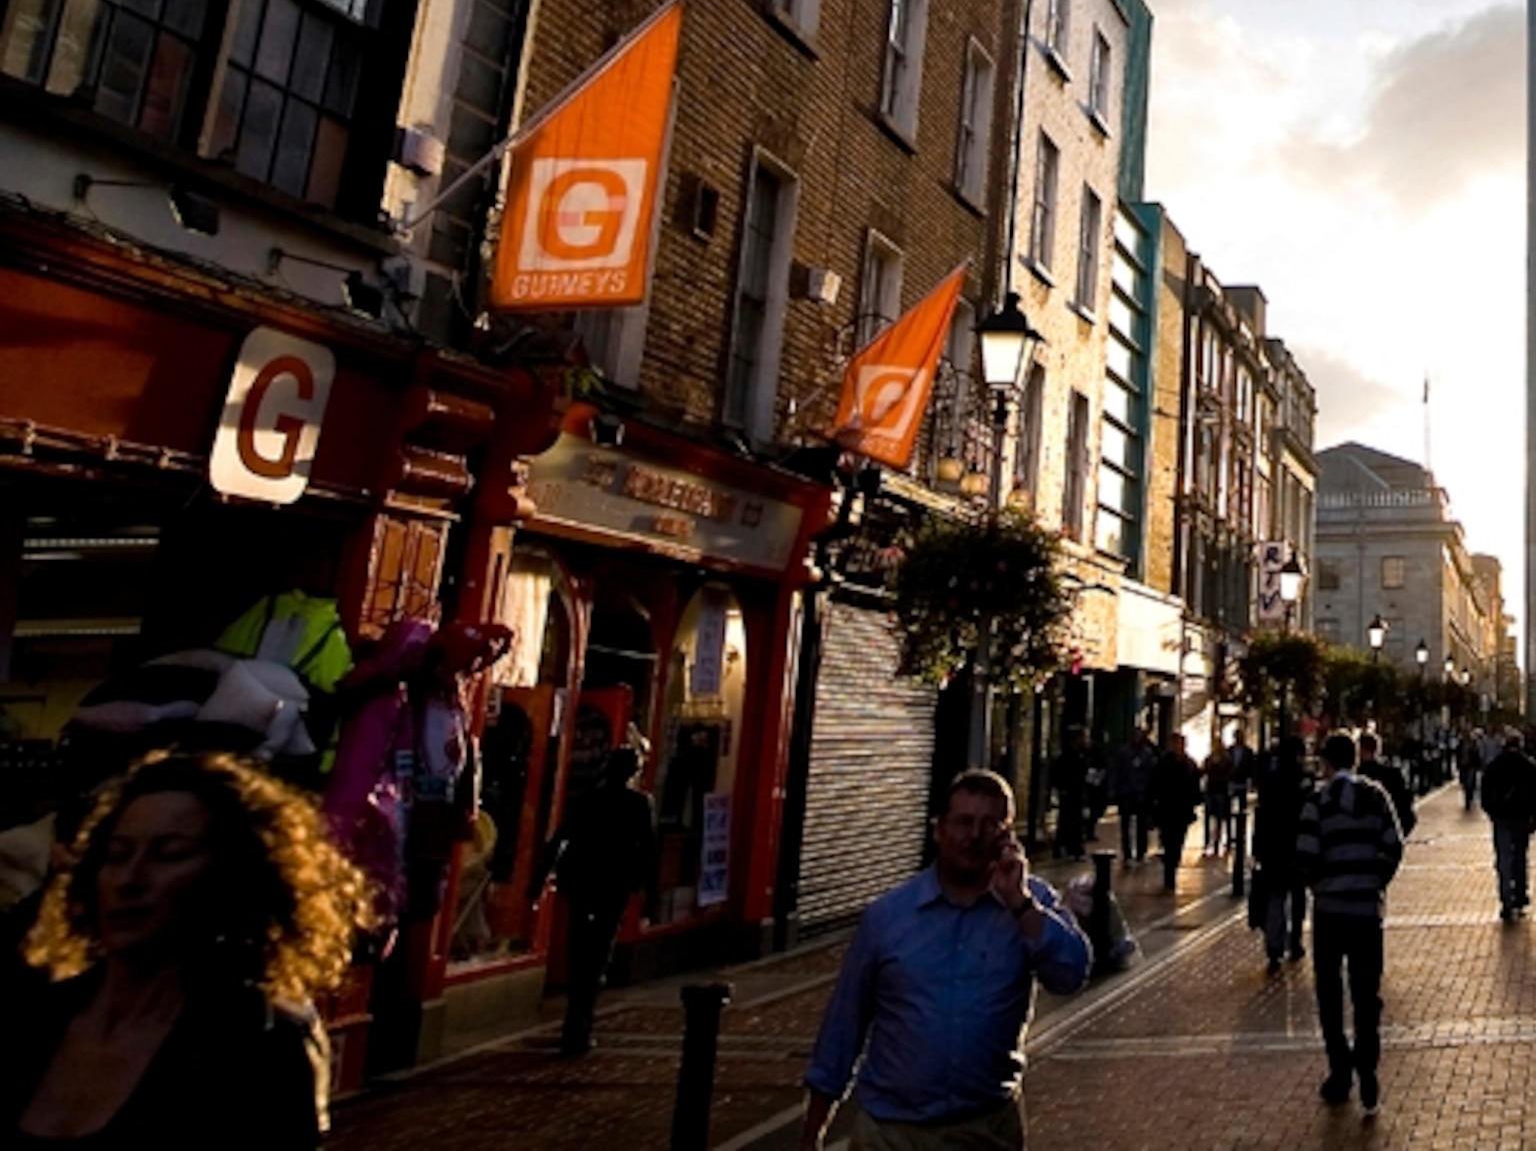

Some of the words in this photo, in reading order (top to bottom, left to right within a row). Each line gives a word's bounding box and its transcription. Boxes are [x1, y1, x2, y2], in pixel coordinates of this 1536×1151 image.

[537, 168, 628, 260] G
[511, 270, 627, 299] GUINEYS
[237, 354, 314, 480] G
